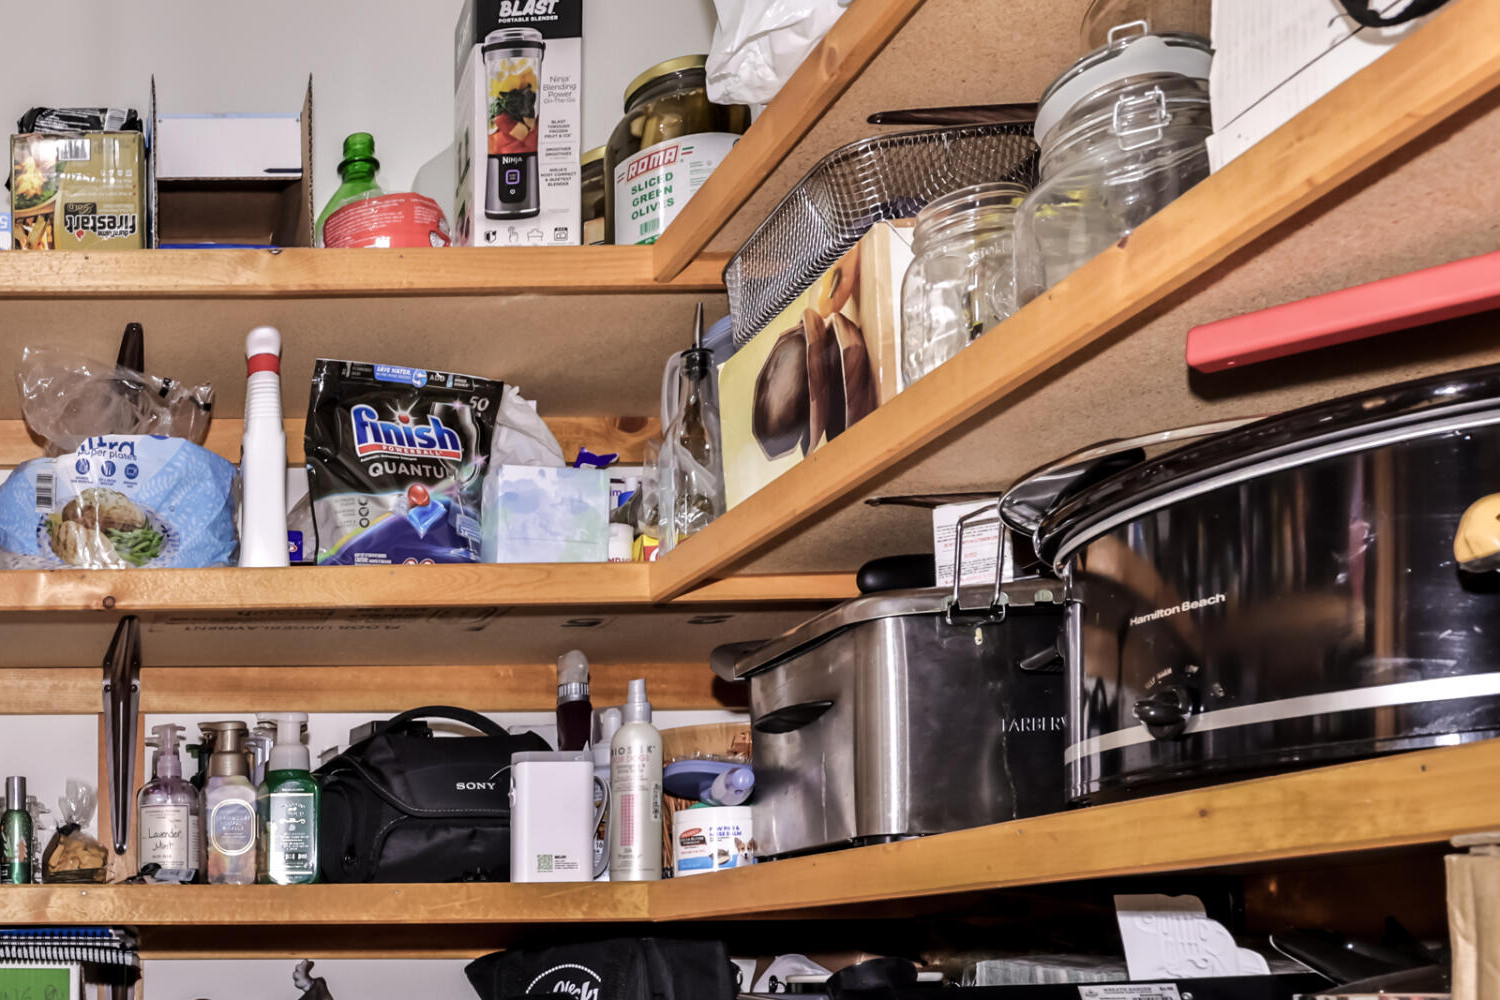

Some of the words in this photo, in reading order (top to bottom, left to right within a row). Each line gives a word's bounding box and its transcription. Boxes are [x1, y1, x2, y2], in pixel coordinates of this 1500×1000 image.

[500, 0, 556, 16] BLAST
[543, 83, 576, 92] Blending
[502, 156, 523, 164] NINJA
[628, 147, 678, 179] ROMA
[631, 198, 674, 220] OLIVS
[65, 215, 137, 234] firestart
[470, 396, 490, 412] 50
[351, 404, 461, 451] finish
[108, 450, 137, 461] plates
[1130, 605, 1181, 627] Hamilton
[1181, 593, 1226, 613] Beach
[456, 782, 496, 791] SONY
[148, 827, 182, 839] Lavender
[152, 841, 173, 852] Mint
